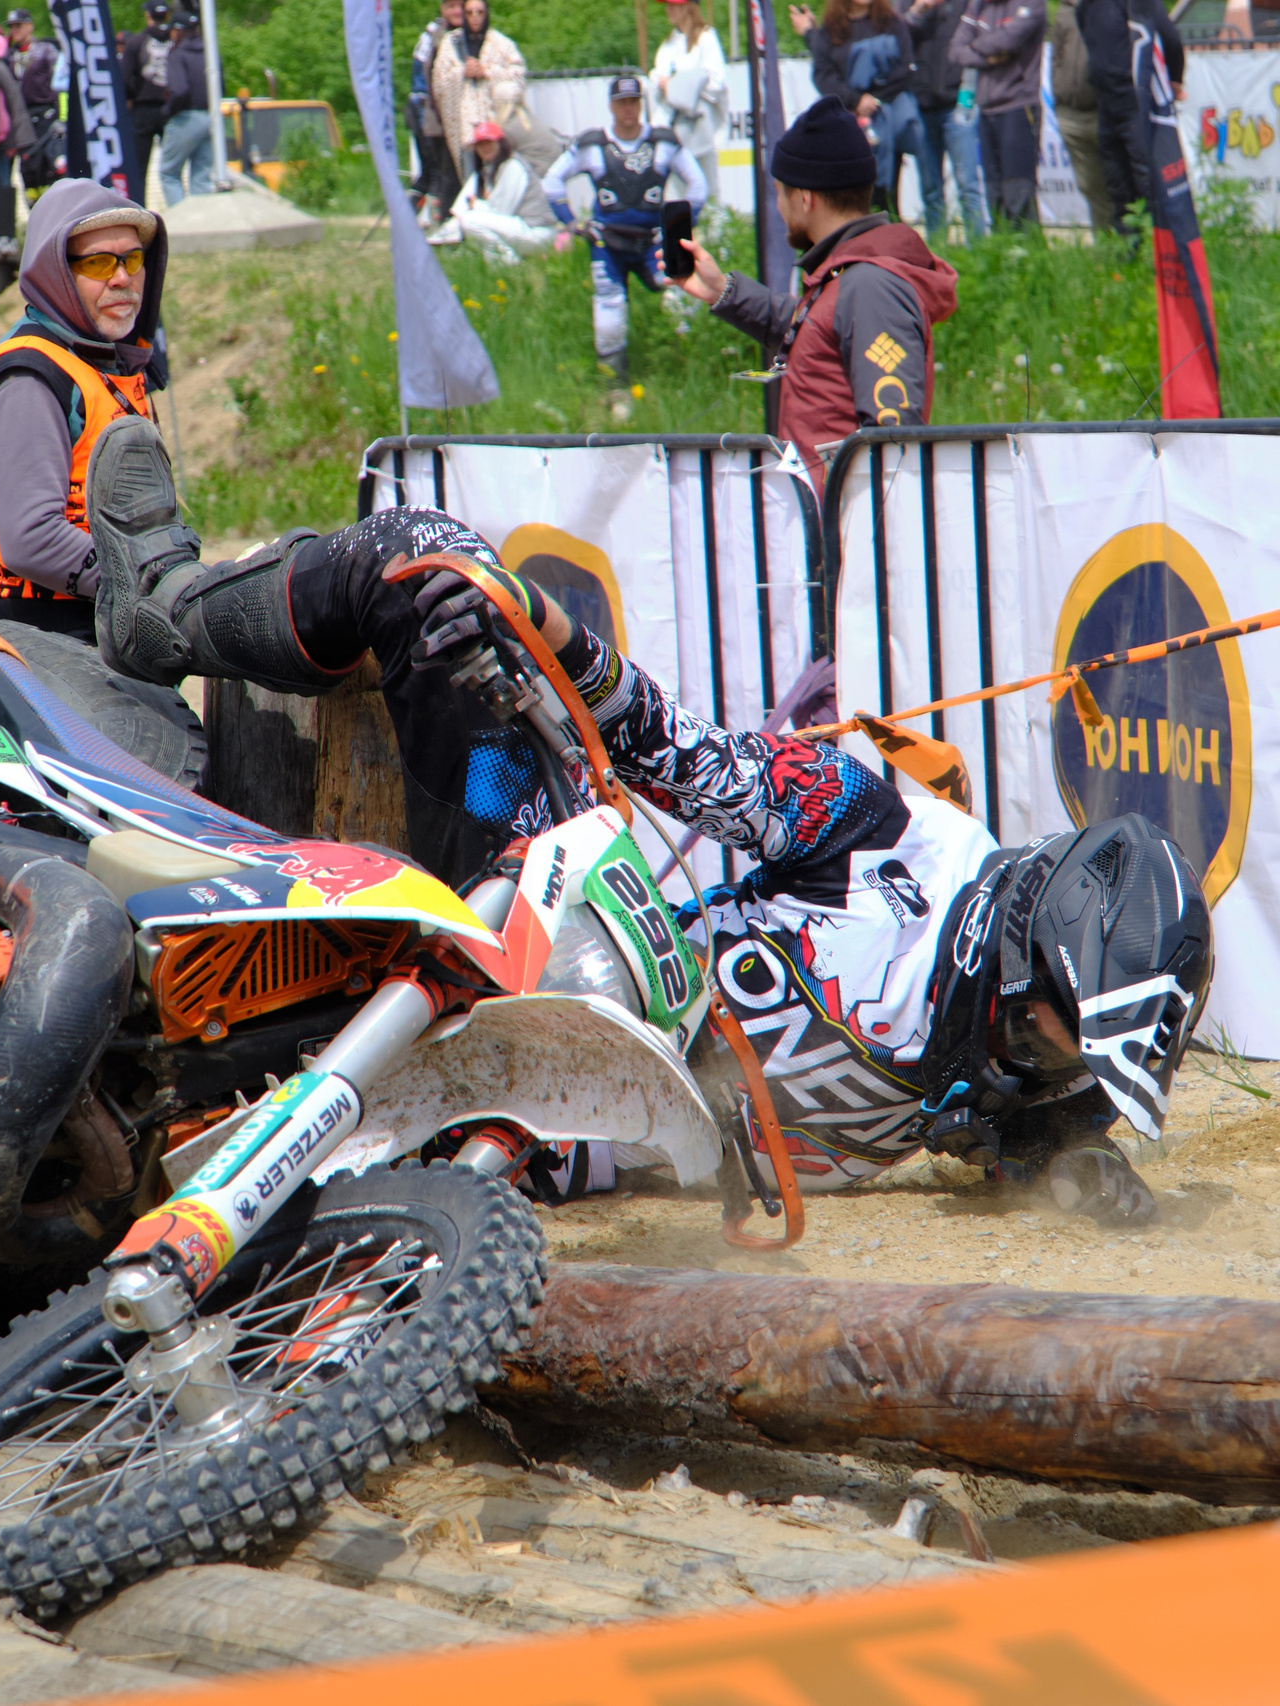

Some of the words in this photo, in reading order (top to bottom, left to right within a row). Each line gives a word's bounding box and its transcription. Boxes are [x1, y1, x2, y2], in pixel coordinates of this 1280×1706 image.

[224, 883, 265, 906] KTM
[541, 862, 566, 910] KTM
[602, 861, 689, 1009] 292
[612, 910, 657, 994] Александр
[621, 909, 659, 985] Стаценко
[1000, 978, 1032, 995] LEATT
[254, 1093, 352, 1200] METZELER
